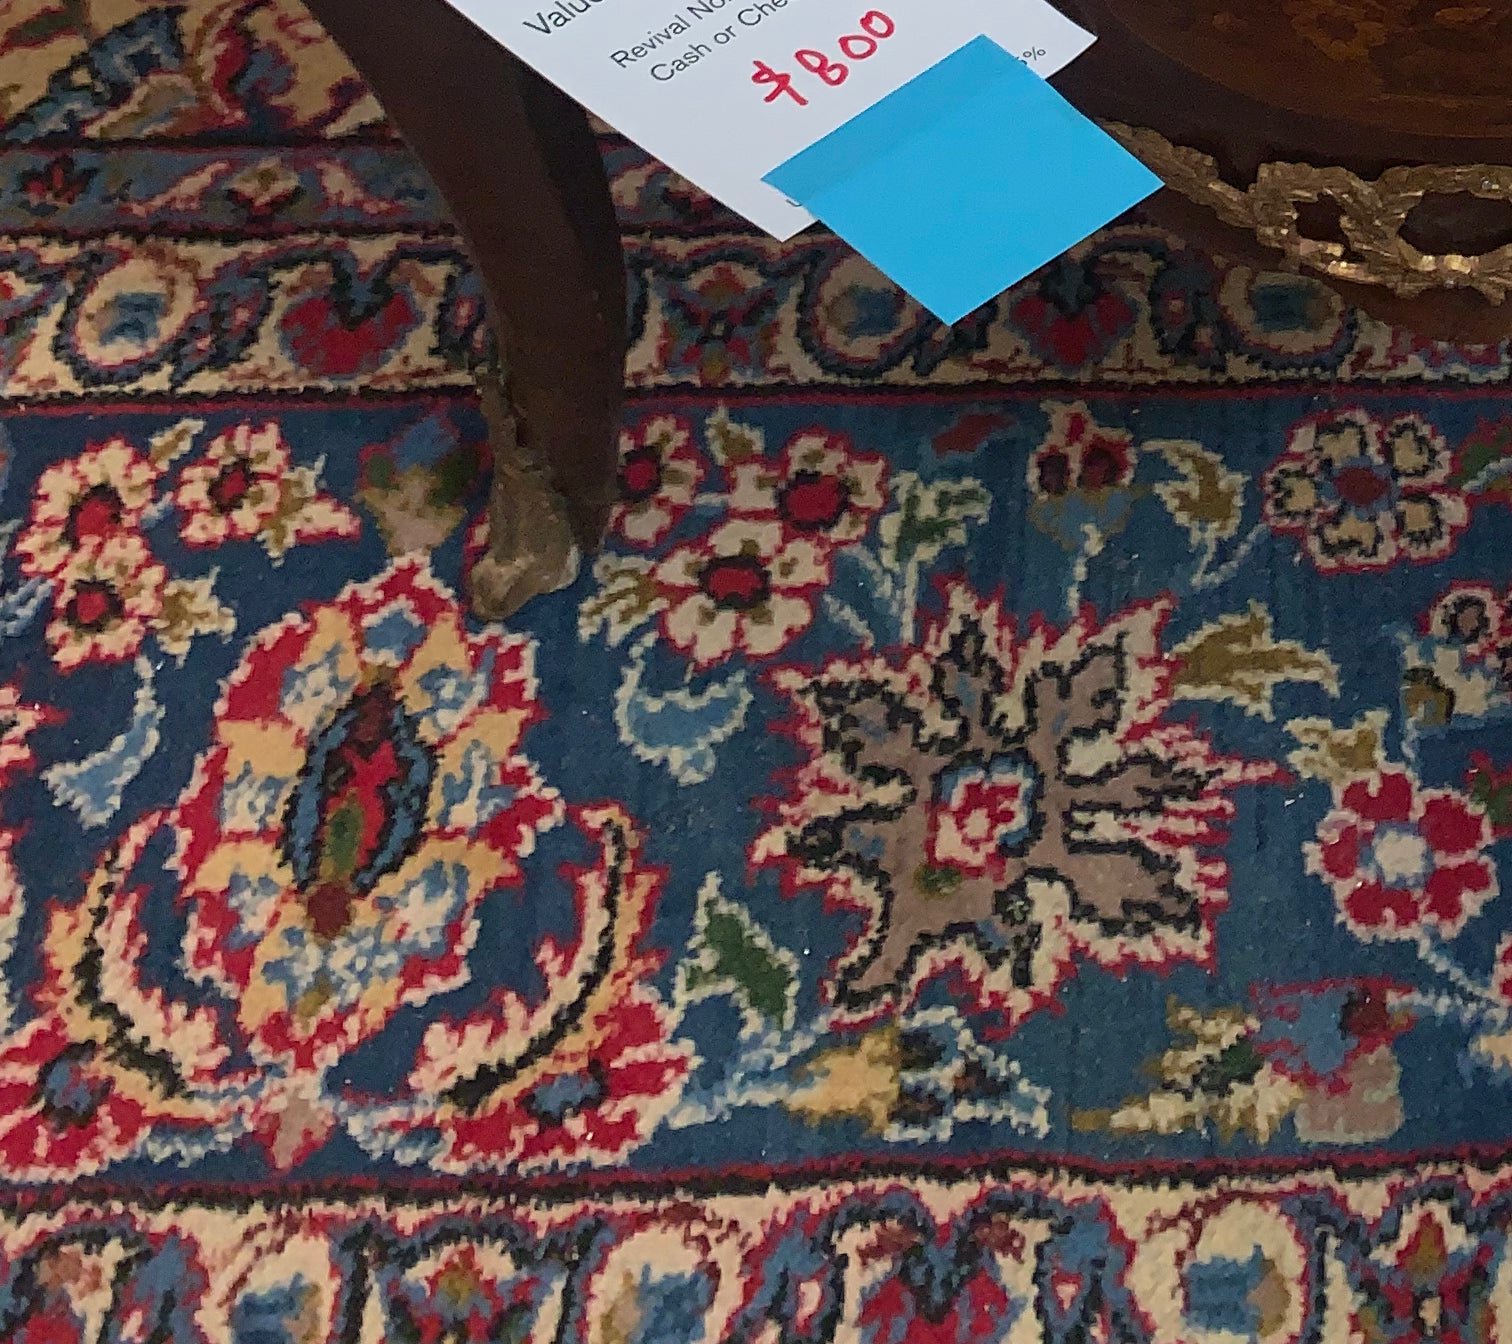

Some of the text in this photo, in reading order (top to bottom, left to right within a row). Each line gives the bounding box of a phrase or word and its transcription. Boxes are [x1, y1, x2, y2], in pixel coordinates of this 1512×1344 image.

[609, 14, 692, 69] Revival
[650, 41, 713, 82] Cash
[712, 25, 738, 46] or
[751, 9, 895, 106] $800
